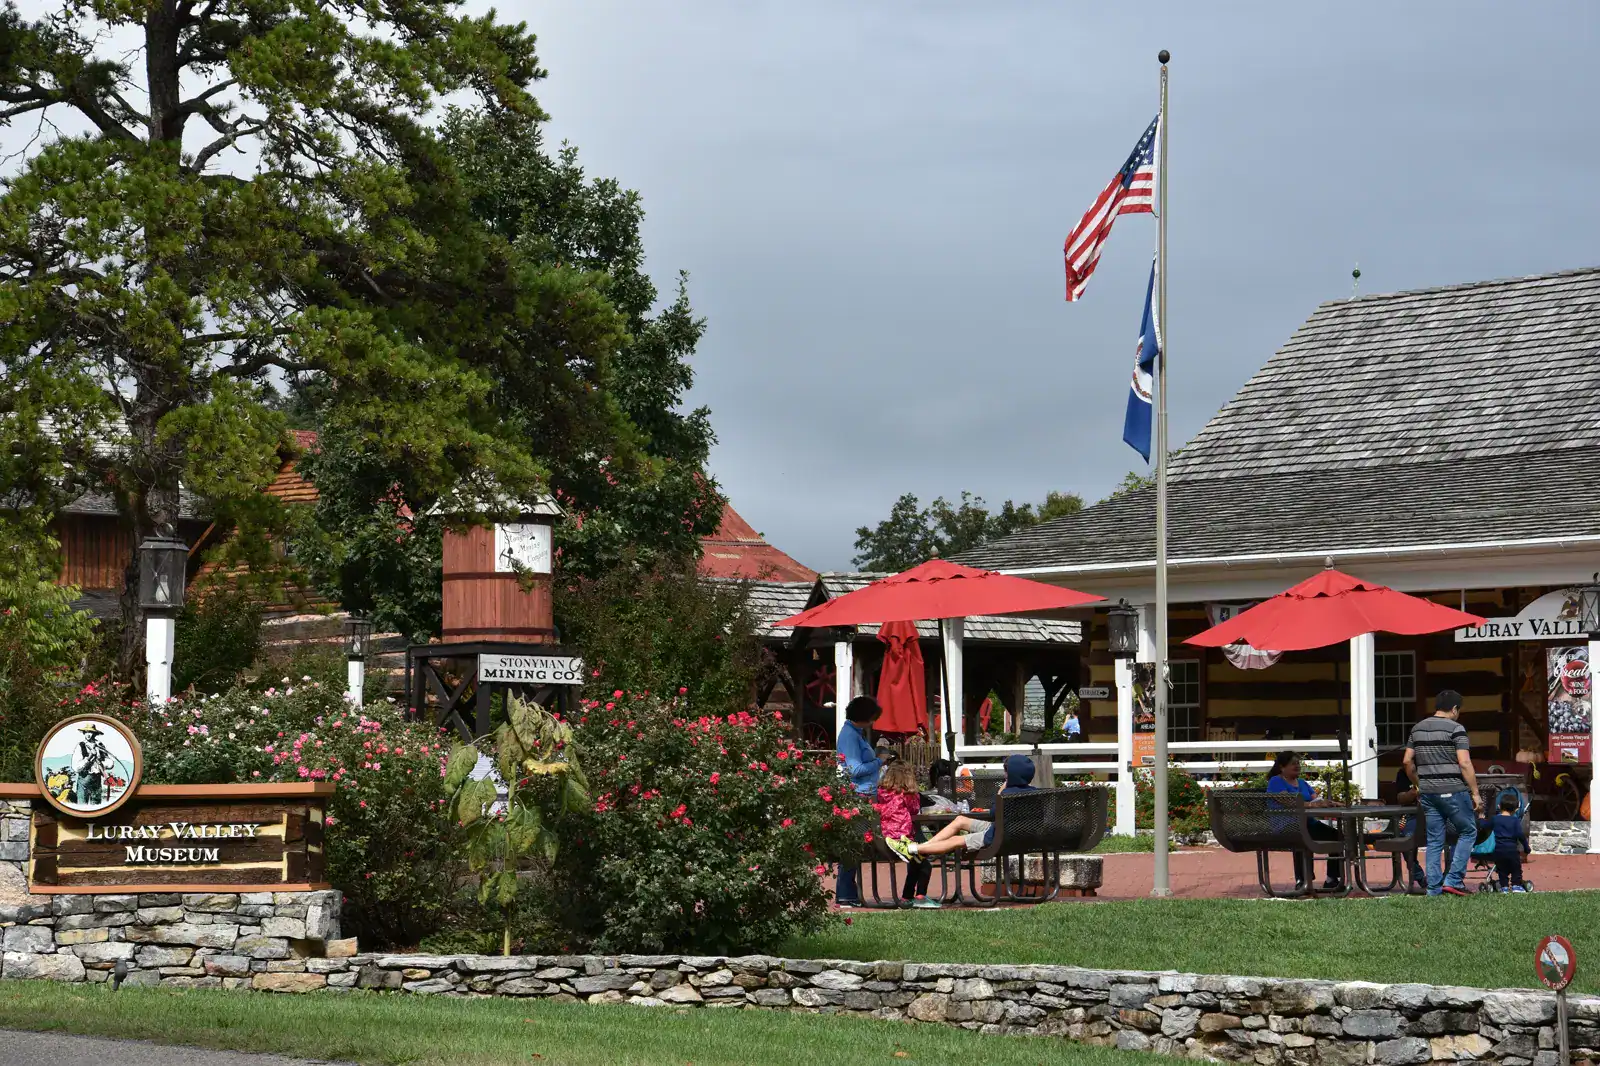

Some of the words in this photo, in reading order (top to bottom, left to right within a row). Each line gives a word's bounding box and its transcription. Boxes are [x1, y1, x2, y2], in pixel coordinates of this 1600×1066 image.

[1464, 622, 1524, 639] LURAY
[500, 657, 565, 669] STONYMAN
[484, 668, 547, 680] MINING
[553, 670, 580, 680] CO.
[1552, 660, 1589, 684] Great
[85, 822, 164, 840] LURAY
[169, 822, 260, 839] VALLEY
[124, 845, 220, 862] MUSEUM
